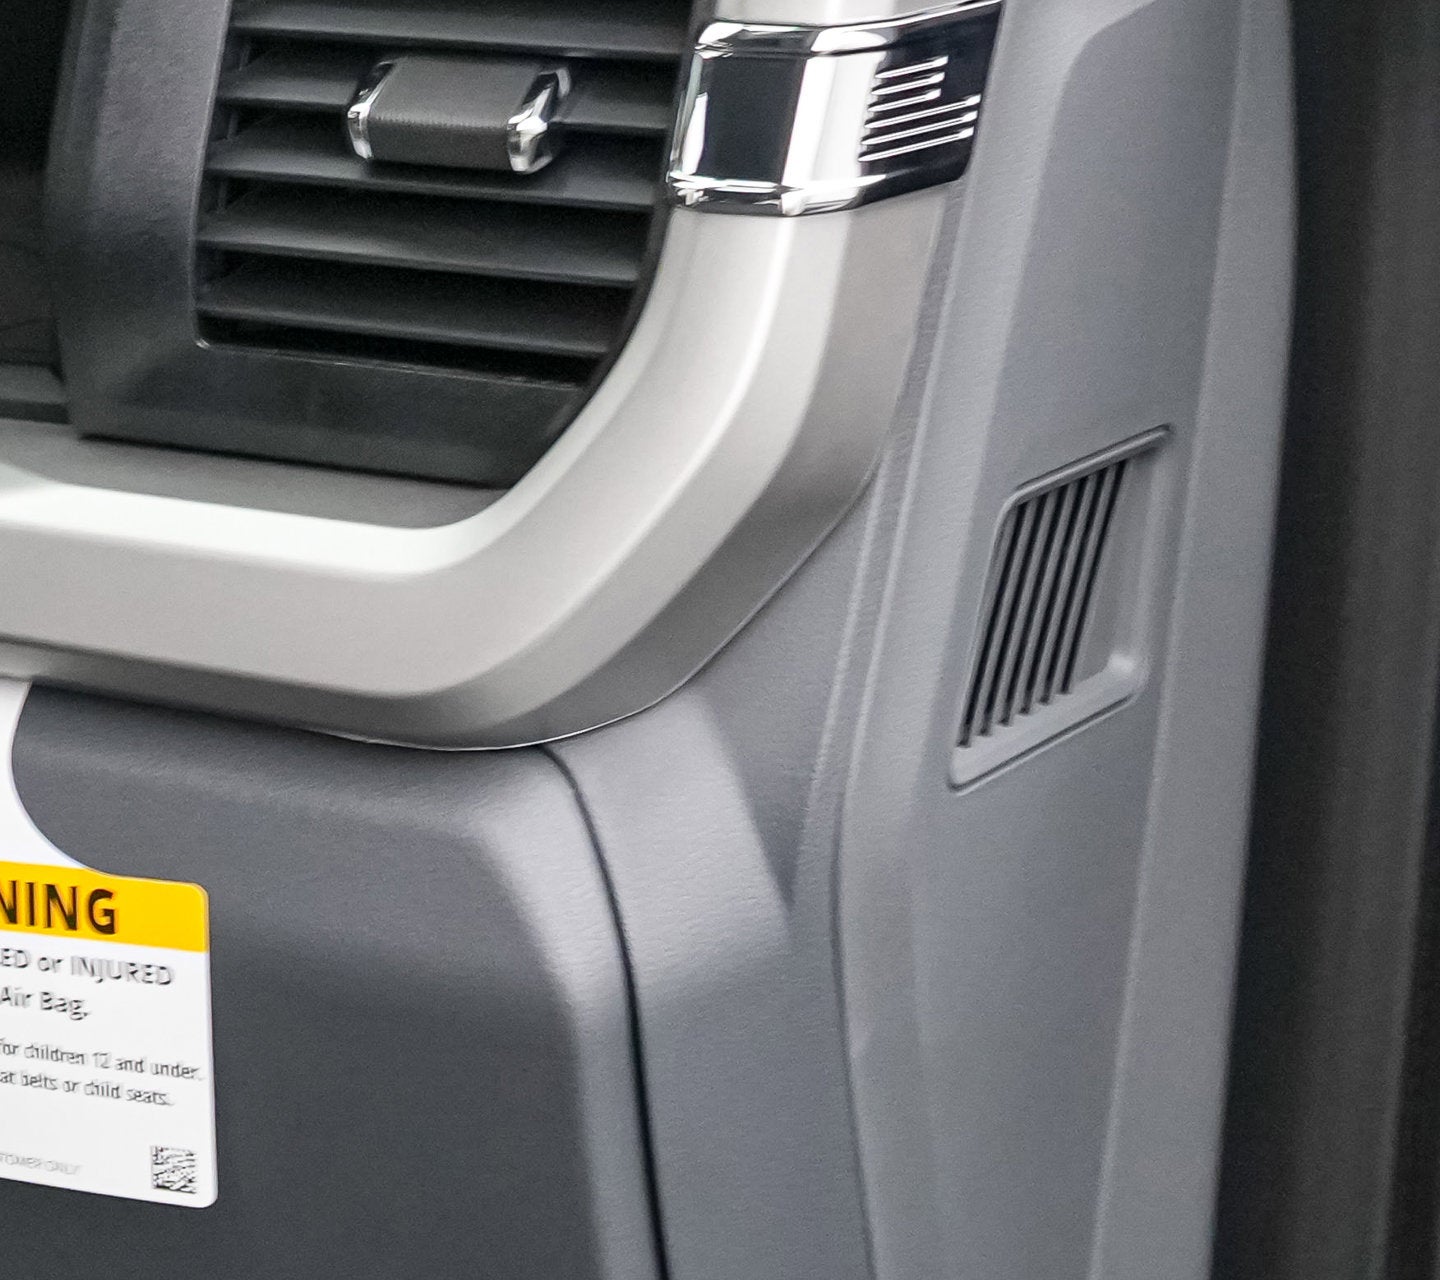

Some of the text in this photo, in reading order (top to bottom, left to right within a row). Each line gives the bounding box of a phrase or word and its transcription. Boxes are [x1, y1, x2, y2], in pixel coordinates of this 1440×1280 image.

[38, 956, 63, 972] or
[71, 956, 174, 986] INJURED
[24, 1042, 86, 1066] children
[92, 1051, 111, 1070] 12
[115, 1057, 145, 1075] and
[21, 1071, 59, 1092] belts
[62, 1080, 79, 1093] or
[84, 1080, 122, 1100] child
